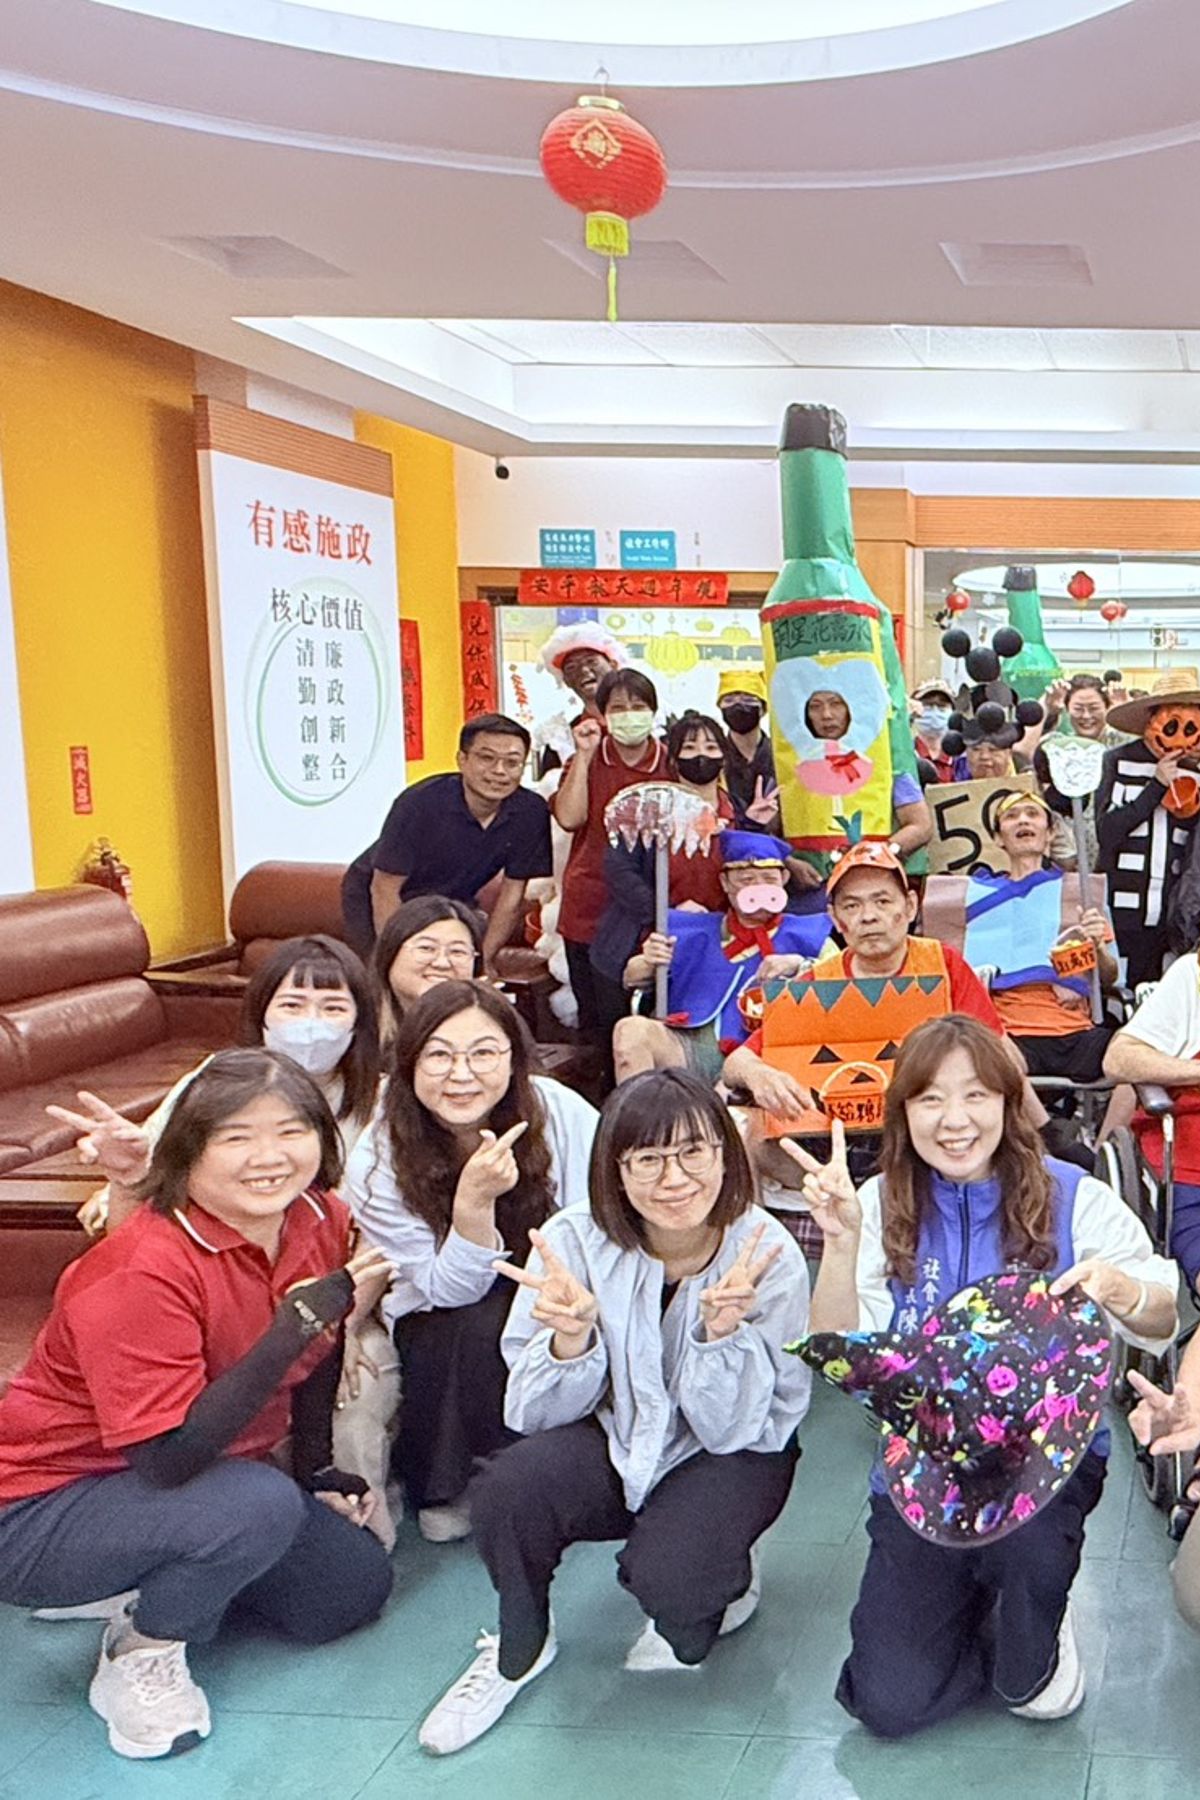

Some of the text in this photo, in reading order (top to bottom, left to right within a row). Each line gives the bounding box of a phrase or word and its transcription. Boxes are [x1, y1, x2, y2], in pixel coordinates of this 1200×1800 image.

[246, 500, 373, 565] 有感施政
[271, 587, 364, 632] 核心價值
[295, 637, 344, 669] 清廉
[297, 675, 345, 706] 勤政
[300, 714, 346, 744] 創新
[302, 751, 348, 782] 整合
